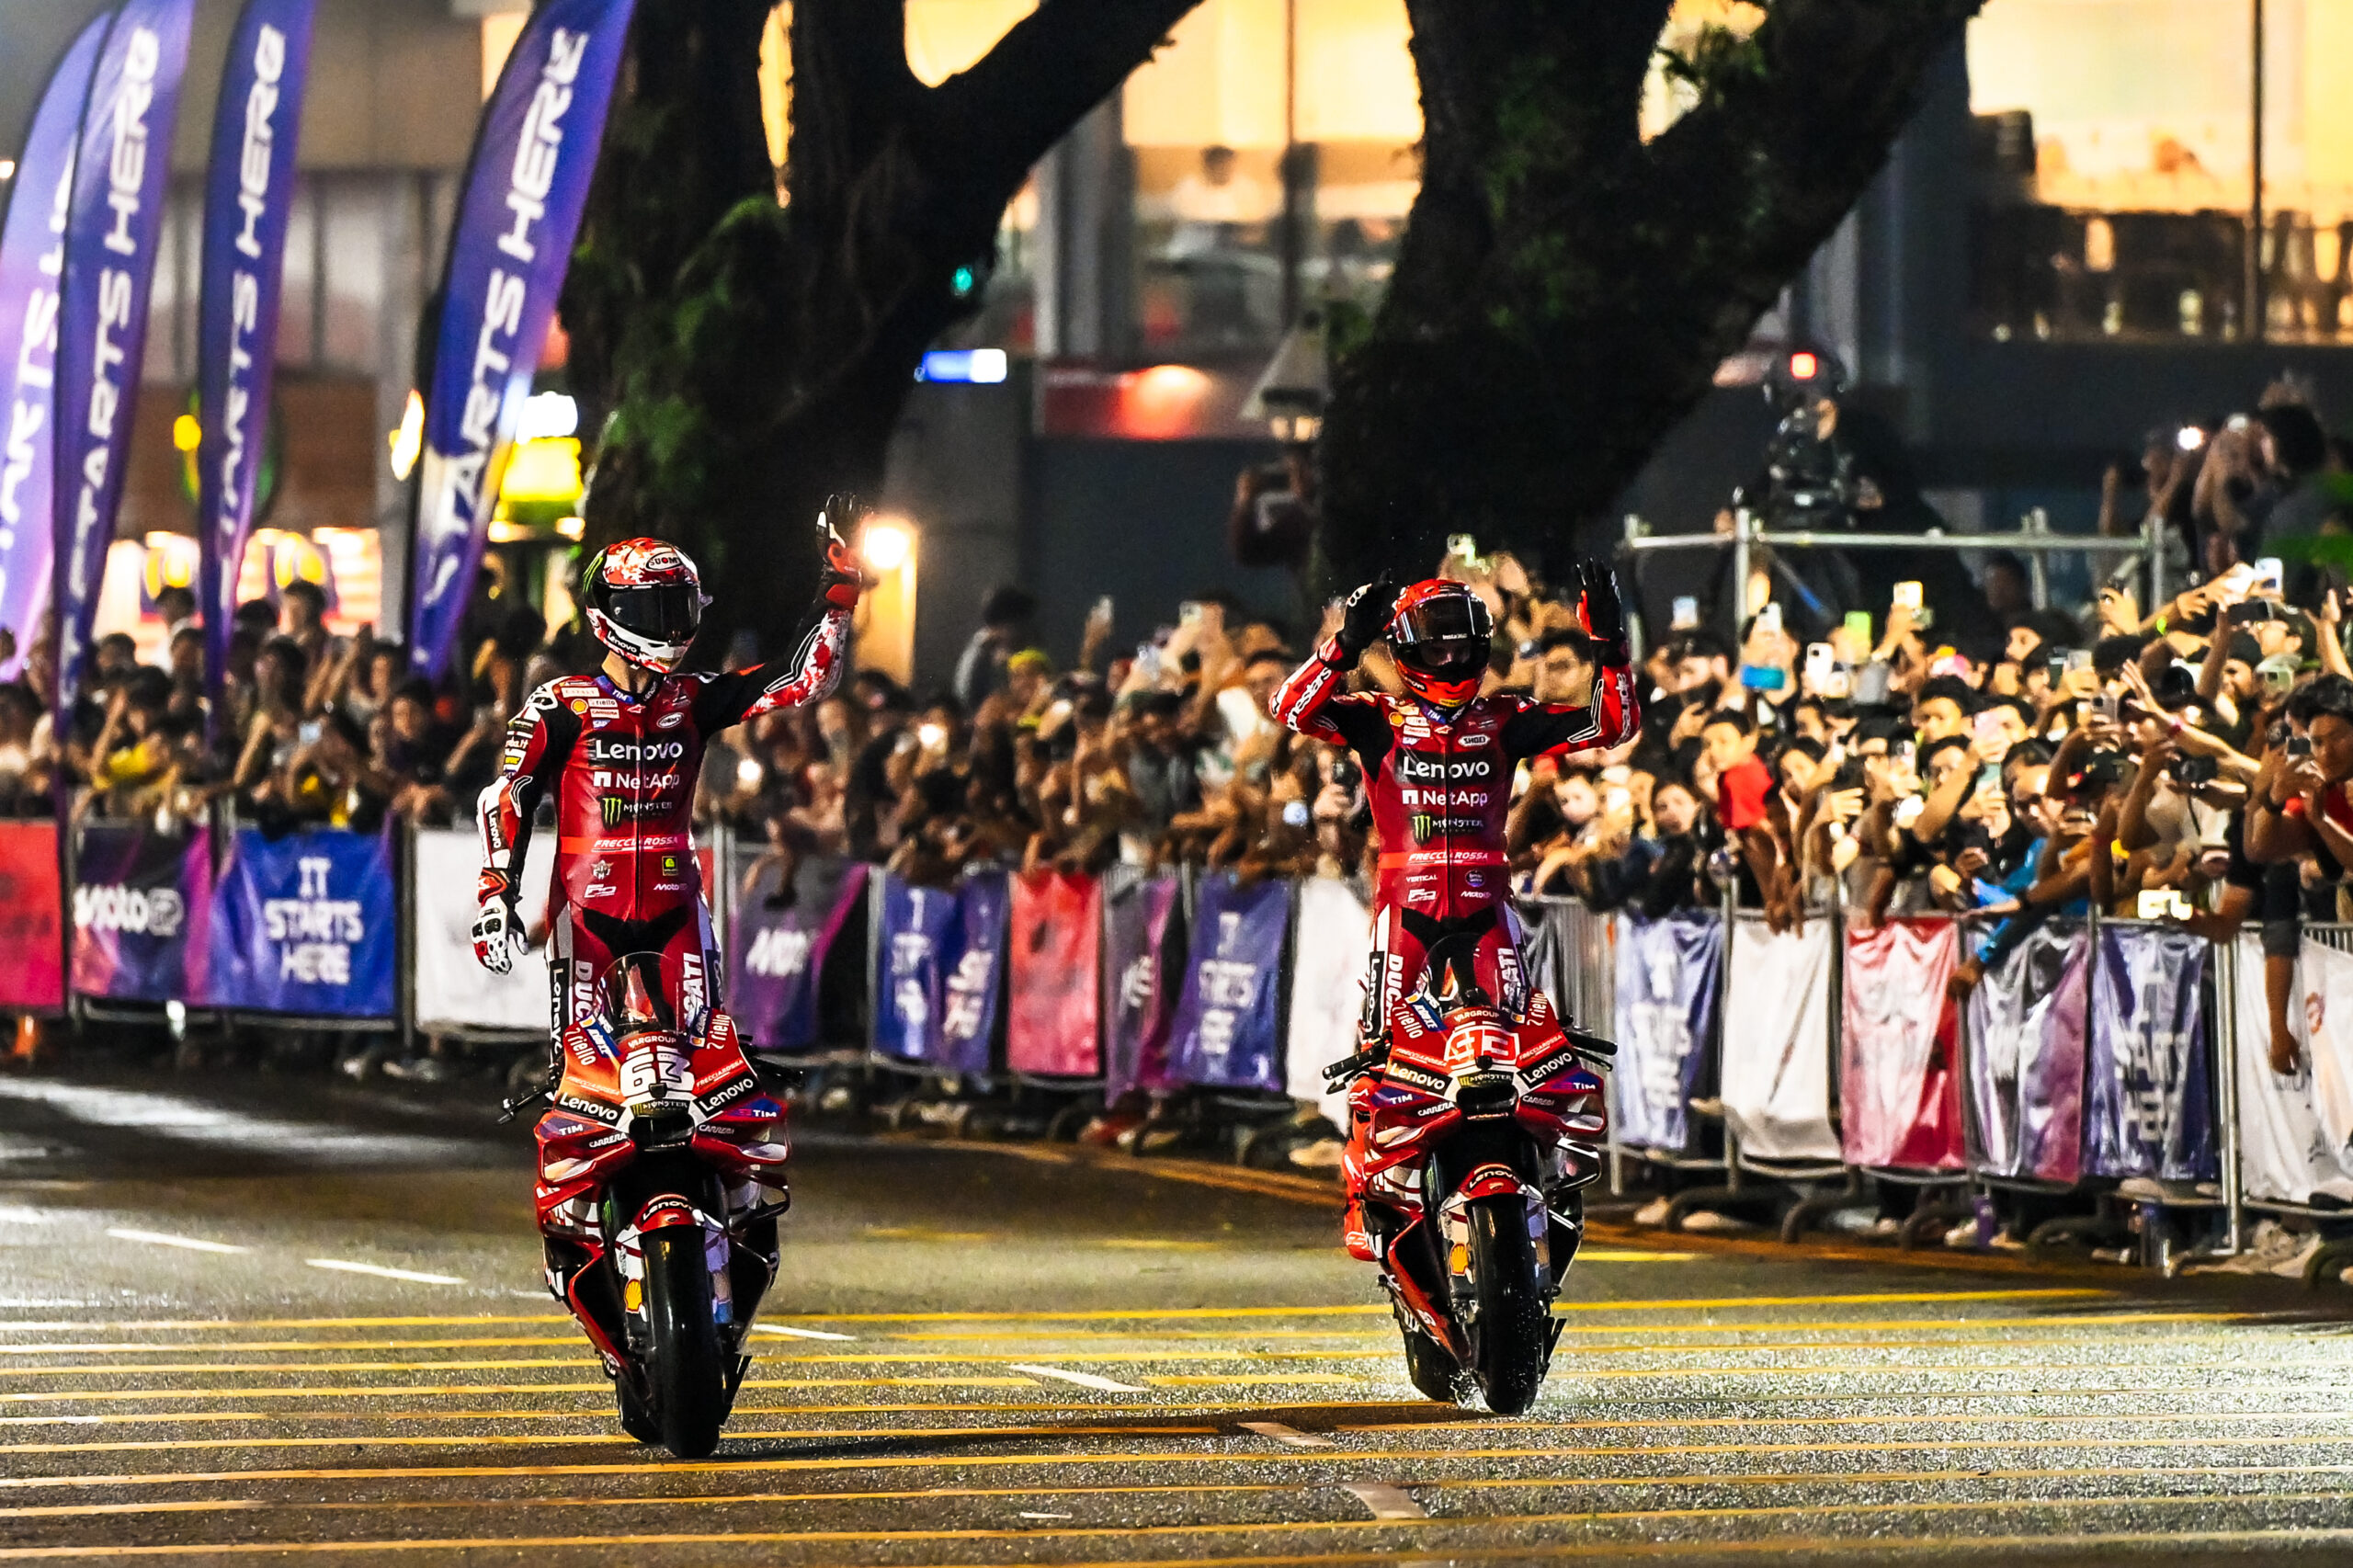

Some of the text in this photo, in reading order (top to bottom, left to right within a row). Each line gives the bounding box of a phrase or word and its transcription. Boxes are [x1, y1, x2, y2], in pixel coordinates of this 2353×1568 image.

[607, 630, 639, 653] Lenovo
[612, 688, 628, 701] TIM
[1427, 710, 1441, 722] TIM
[596, 739, 683, 761] Lenovo
[1403, 756, 1490, 779] Lenovo
[616, 773, 680, 790] NetApp
[1422, 790, 1488, 807] NetApp
[488, 811, 501, 848] Lenovo
[298, 857, 333, 899] IT
[1530, 993, 1548, 1018] riello
[711, 1014, 731, 1041] riello
[1394, 1009, 1424, 1039] riello
[568, 1035, 597, 1066] riello
[620, 1046, 696, 1097] 63
[1389, 1062, 1446, 1090] Lenovo
[1522, 1051, 1573, 1084] Lenovo
[699, 1078, 754, 1112] Lenovo
[1573, 1082, 1597, 1090] TIM
[559, 1092, 618, 1120] Lenovo
[1390, 1093, 1413, 1105] TIM
[1417, 1101, 1455, 1117] CARRERA
[753, 1109, 778, 1118] TIM
[559, 1123, 584, 1136] TIM
[589, 1132, 627, 1148] CARRERA
